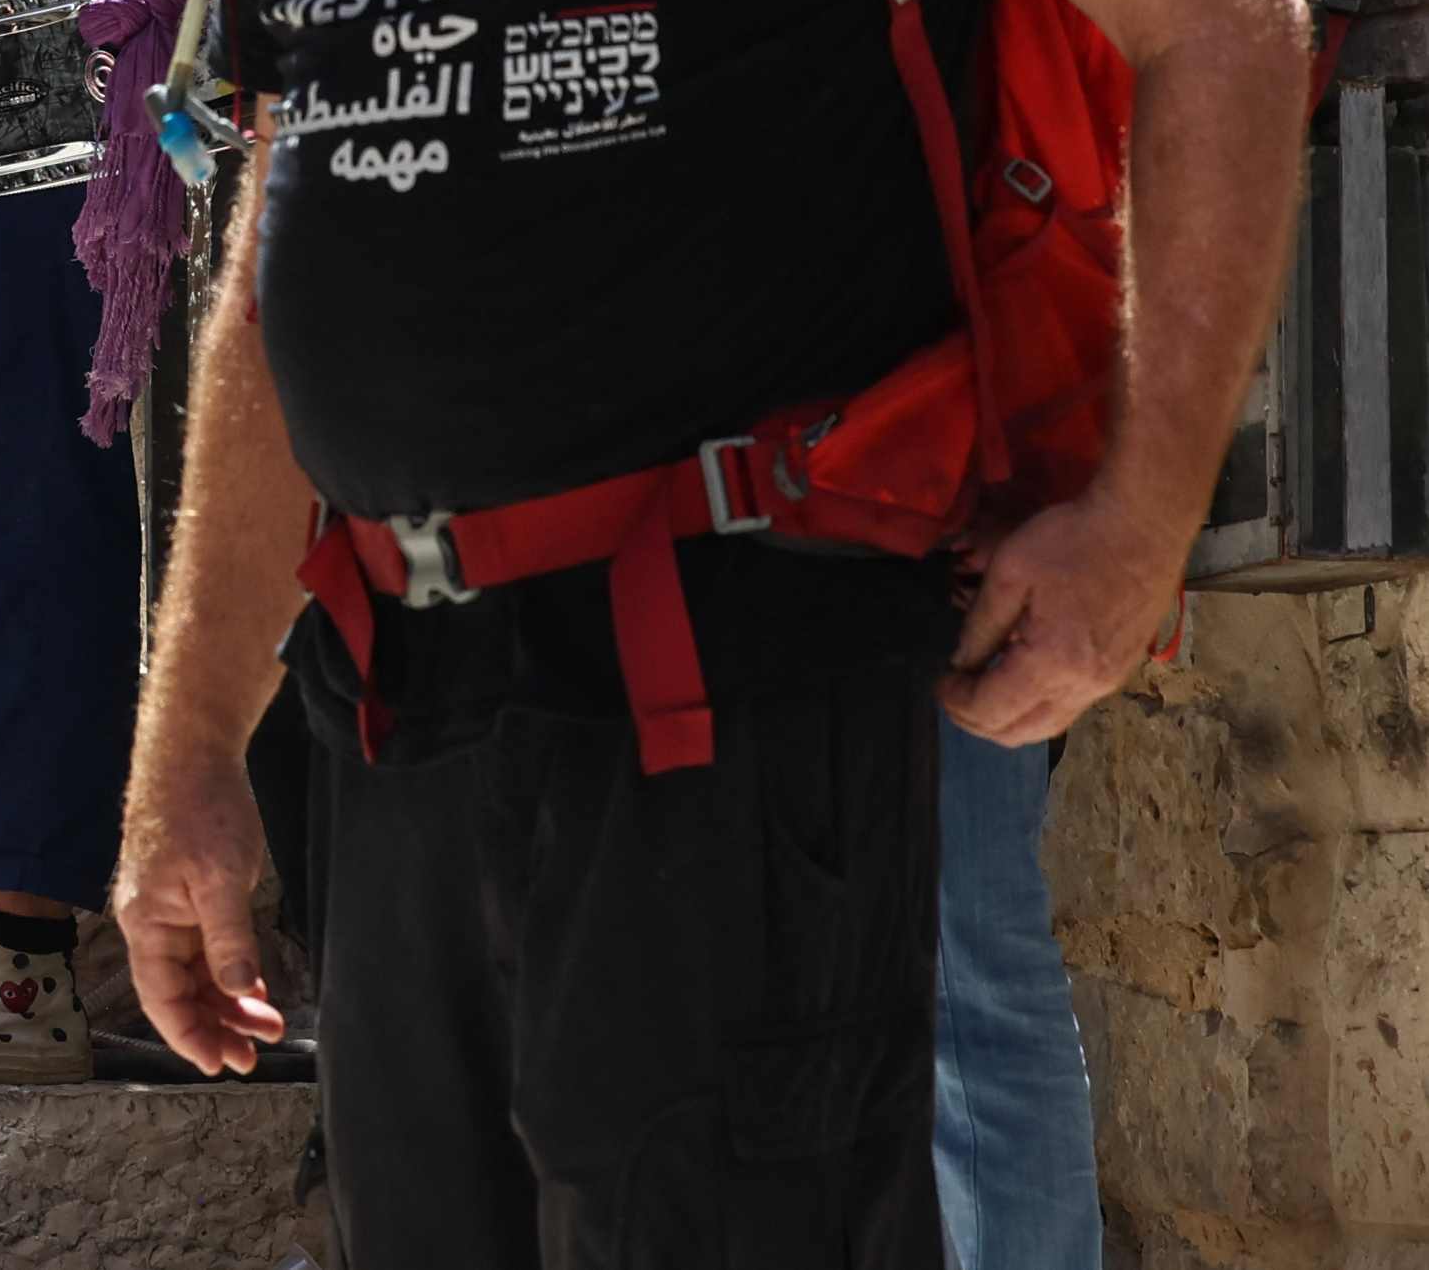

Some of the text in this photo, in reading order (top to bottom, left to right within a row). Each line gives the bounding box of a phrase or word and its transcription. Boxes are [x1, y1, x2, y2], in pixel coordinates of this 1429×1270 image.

[504, 11, 659, 54] מסתכלים
[503, 41, 661, 86] לכיבוש
[502, 73, 661, 122] בעיניים
